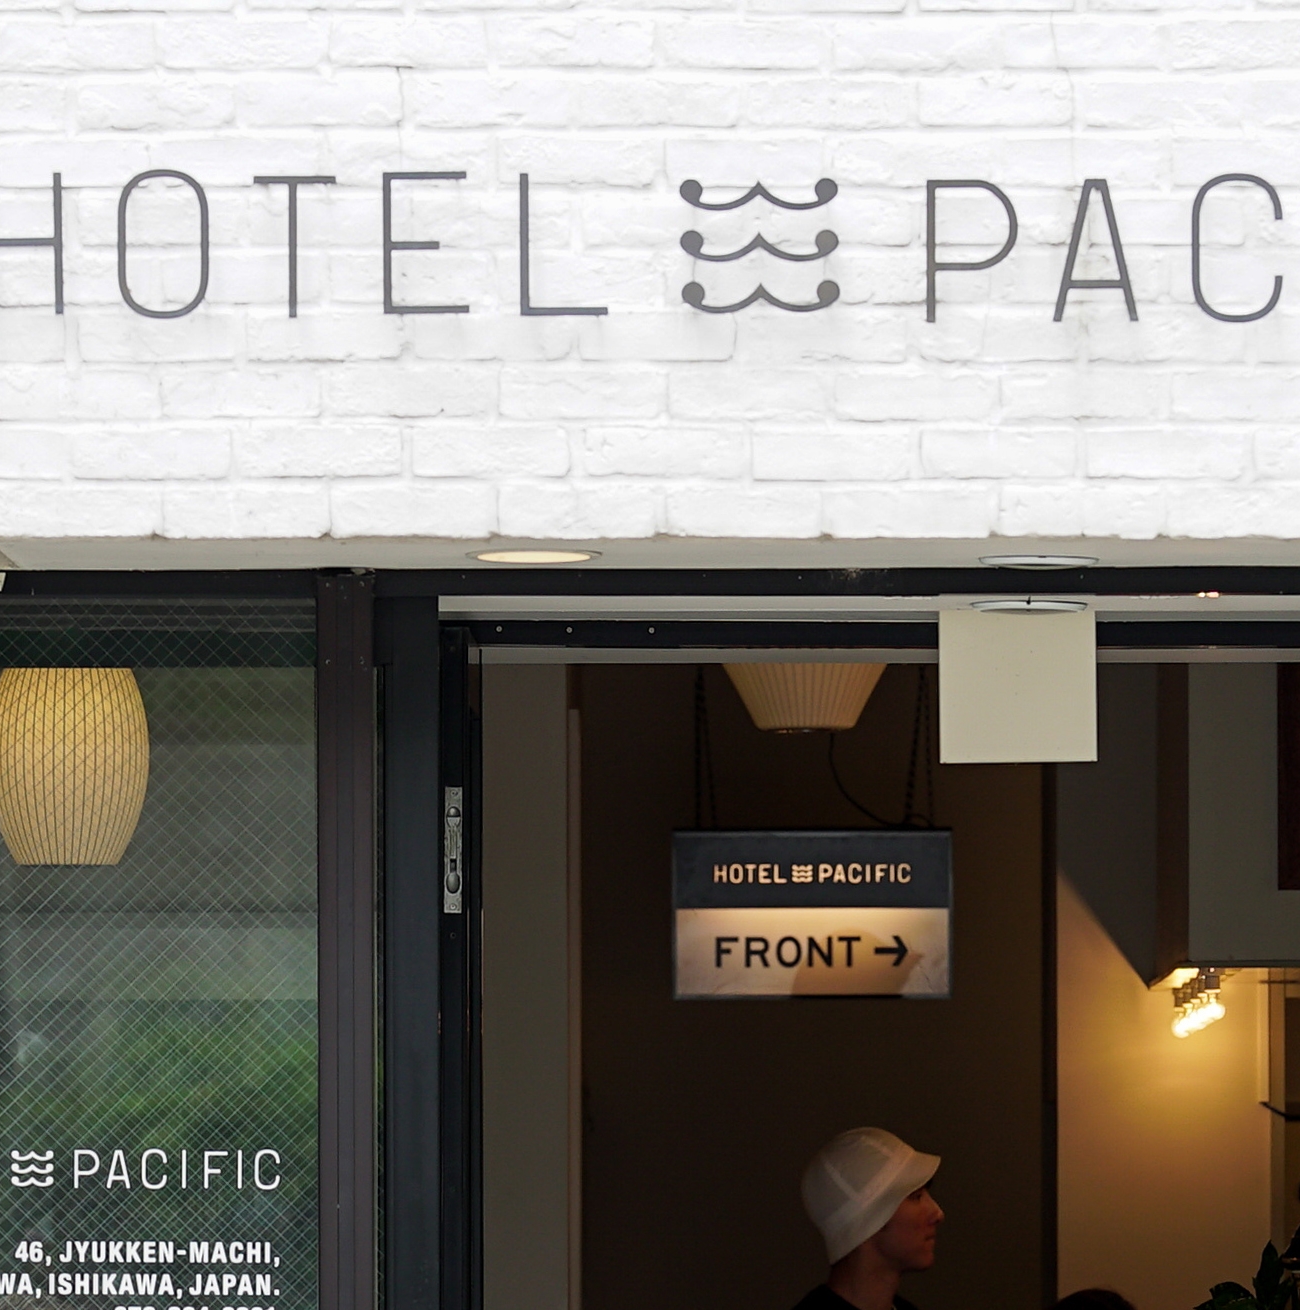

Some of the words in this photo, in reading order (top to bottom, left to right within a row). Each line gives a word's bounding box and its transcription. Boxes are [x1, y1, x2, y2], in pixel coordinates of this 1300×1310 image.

[713, 863, 788, 884] HOTEL
[818, 863, 912, 884] PACIFIC
[715, 936, 861, 968] FRONT
[73, 1148, 281, 1191] PACIFIC
[15, 1240, 52, 1266] 46,
[59, 1240, 281, 1267] JYUKKEN-MACHI,
[48, 1273, 183, 1299] ISHIKAWA,
[189, 1273, 280, 1298] JAPAN.
